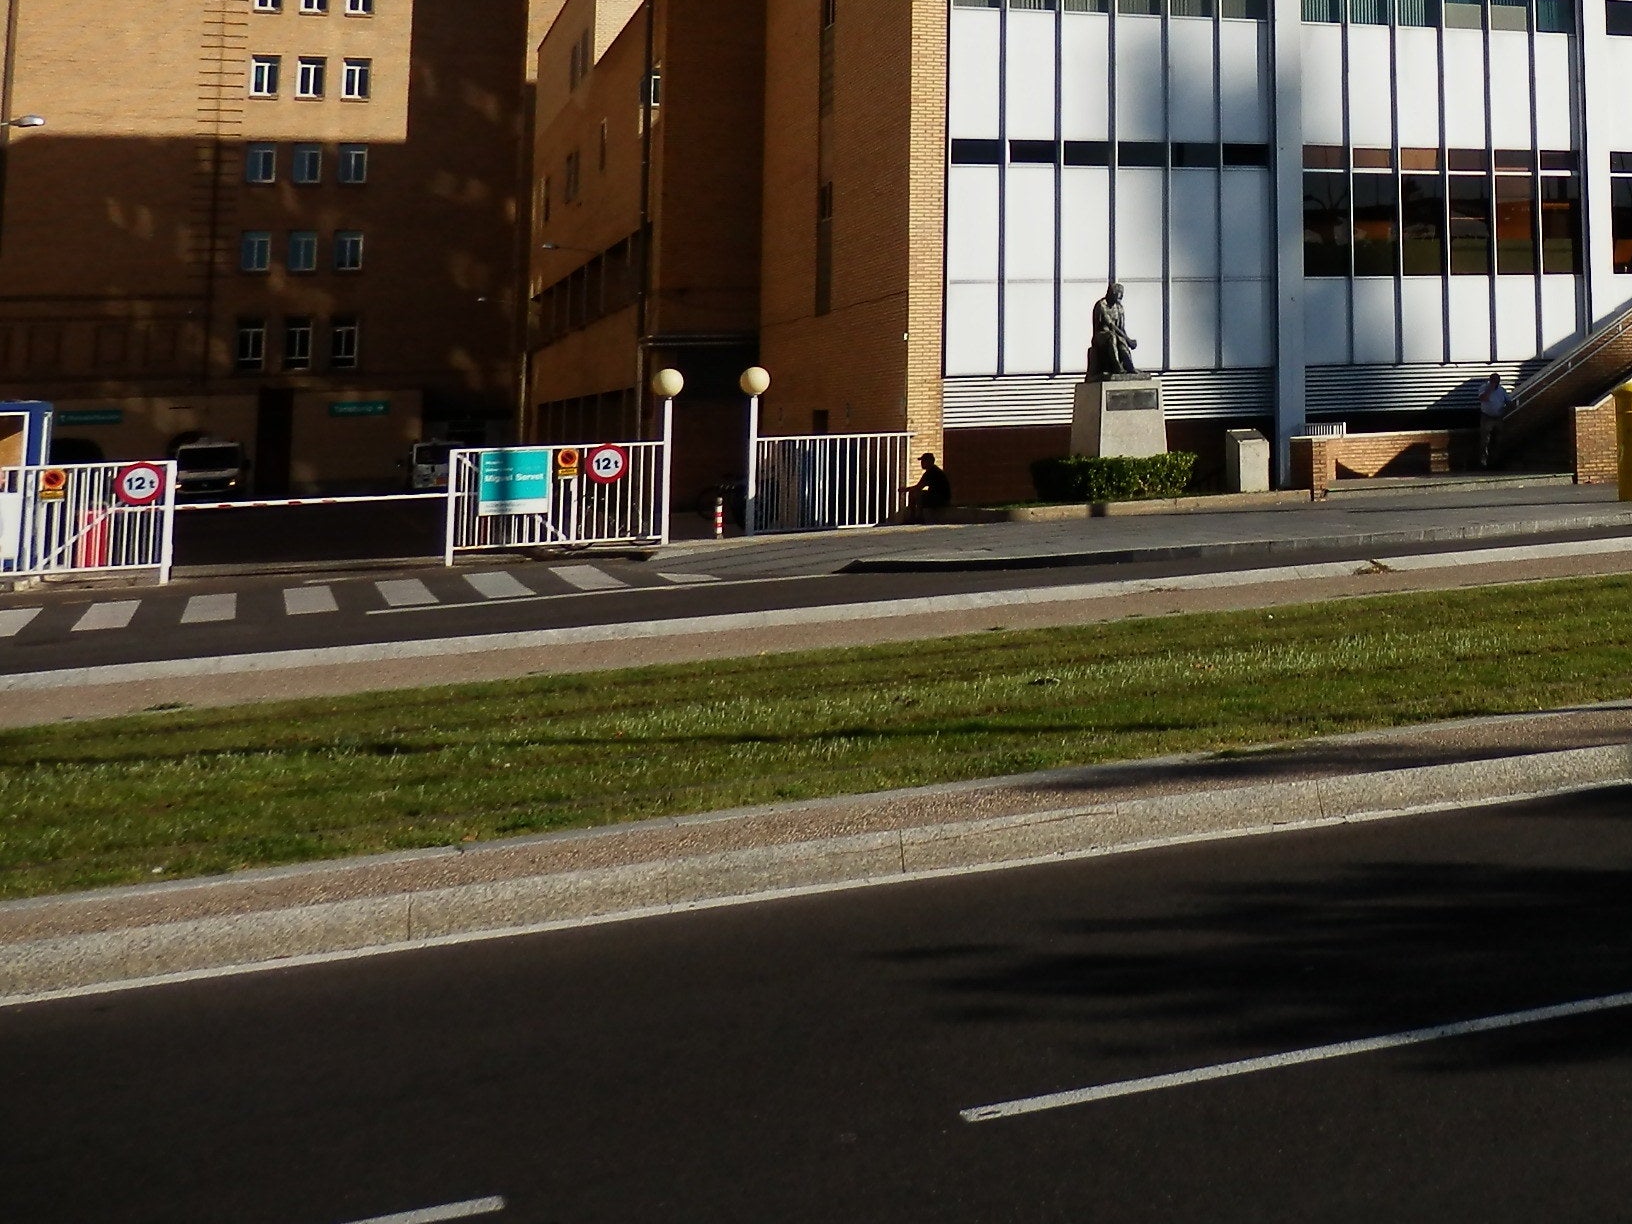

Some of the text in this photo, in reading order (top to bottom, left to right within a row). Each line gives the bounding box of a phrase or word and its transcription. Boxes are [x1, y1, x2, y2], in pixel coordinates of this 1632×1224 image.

[594, 457, 620, 471] 12 t
[126, 476, 155, 491] 12 t
